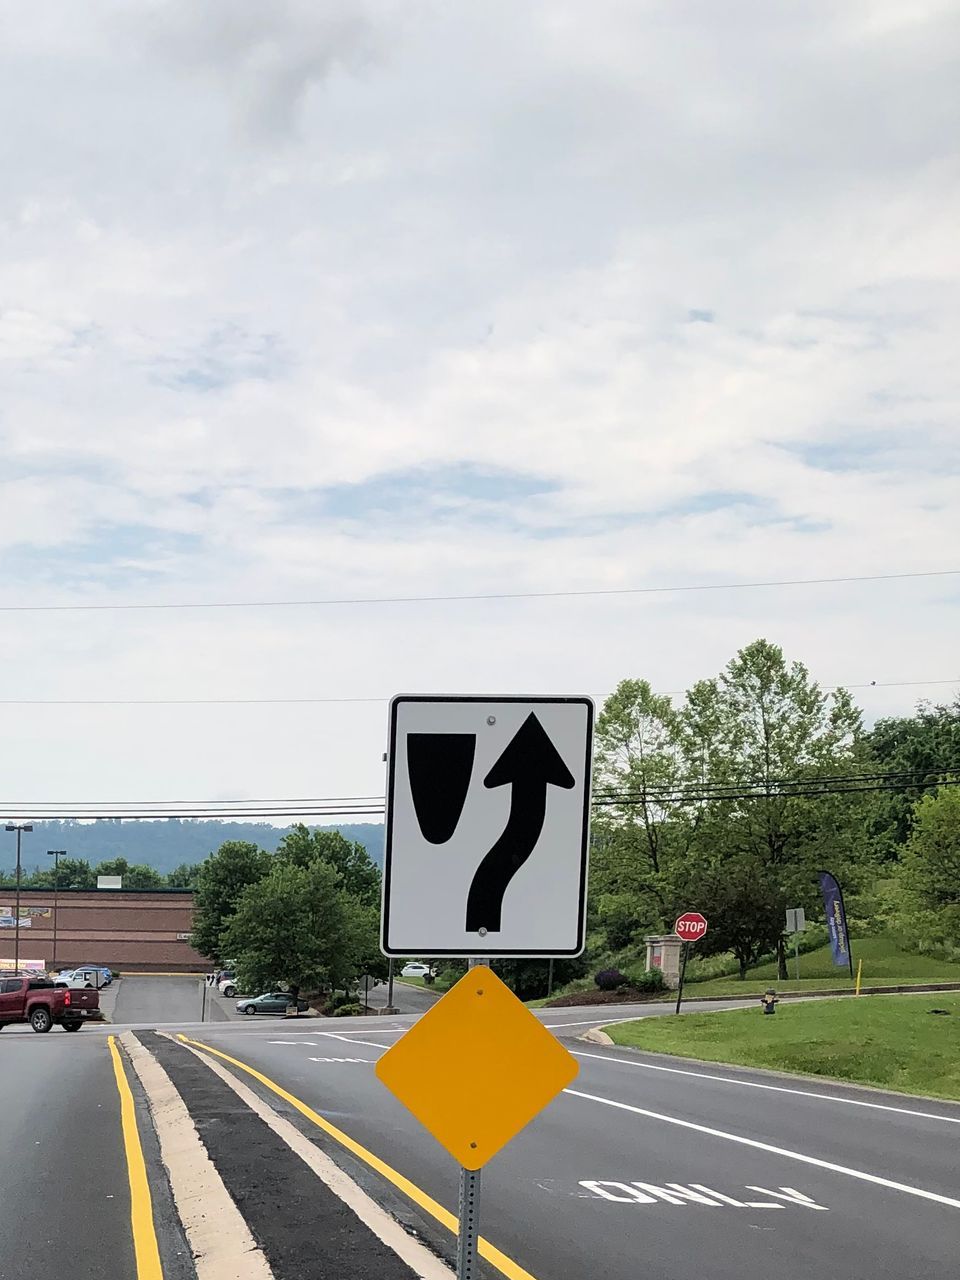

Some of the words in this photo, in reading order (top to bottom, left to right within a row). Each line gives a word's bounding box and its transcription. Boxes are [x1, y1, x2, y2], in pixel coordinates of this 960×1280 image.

[833, 900, 842, 924] delivery
[677, 920, 705, 933] STOP
[838, 932, 846, 953] pickup
[578, 1180, 830, 1211] ONLY
